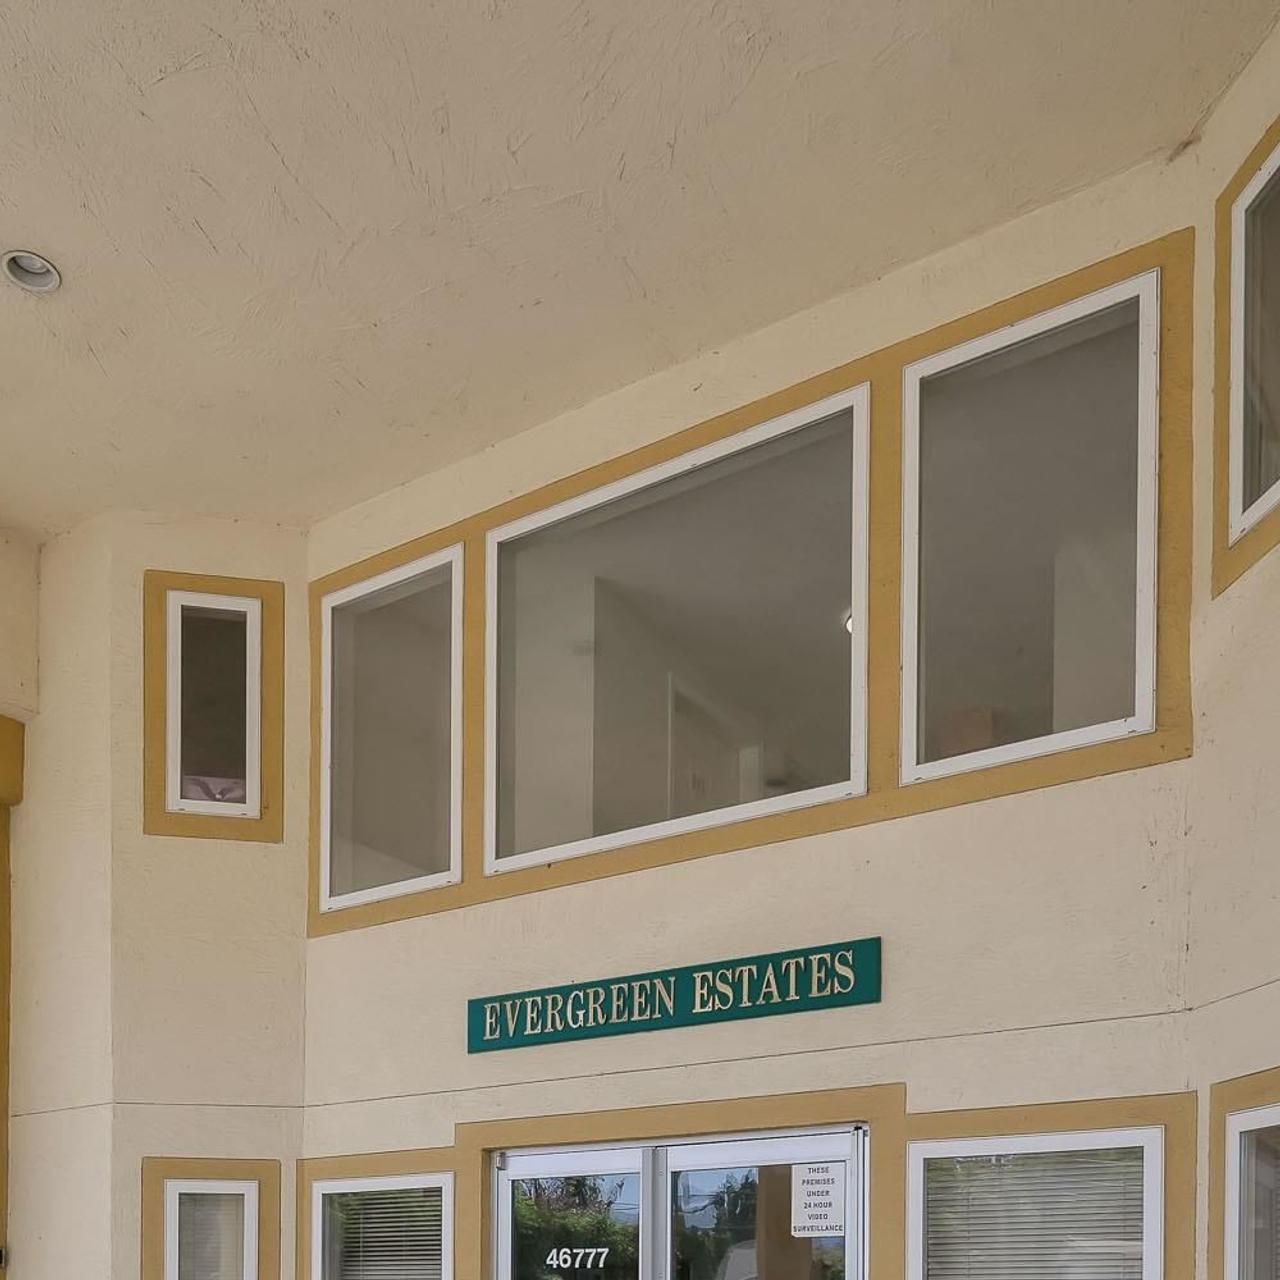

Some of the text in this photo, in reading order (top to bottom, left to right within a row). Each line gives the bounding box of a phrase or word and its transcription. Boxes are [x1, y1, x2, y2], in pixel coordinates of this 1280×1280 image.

[483, 950, 856, 1041] EVERGREEN ESTATES
[807, 1166, 830, 1174] THESE
[801, 1178, 835, 1186] PREMISES
[793, 1224, 843, 1232] SURVEILLANCE
[545, 1248, 610, 1269] 46777
